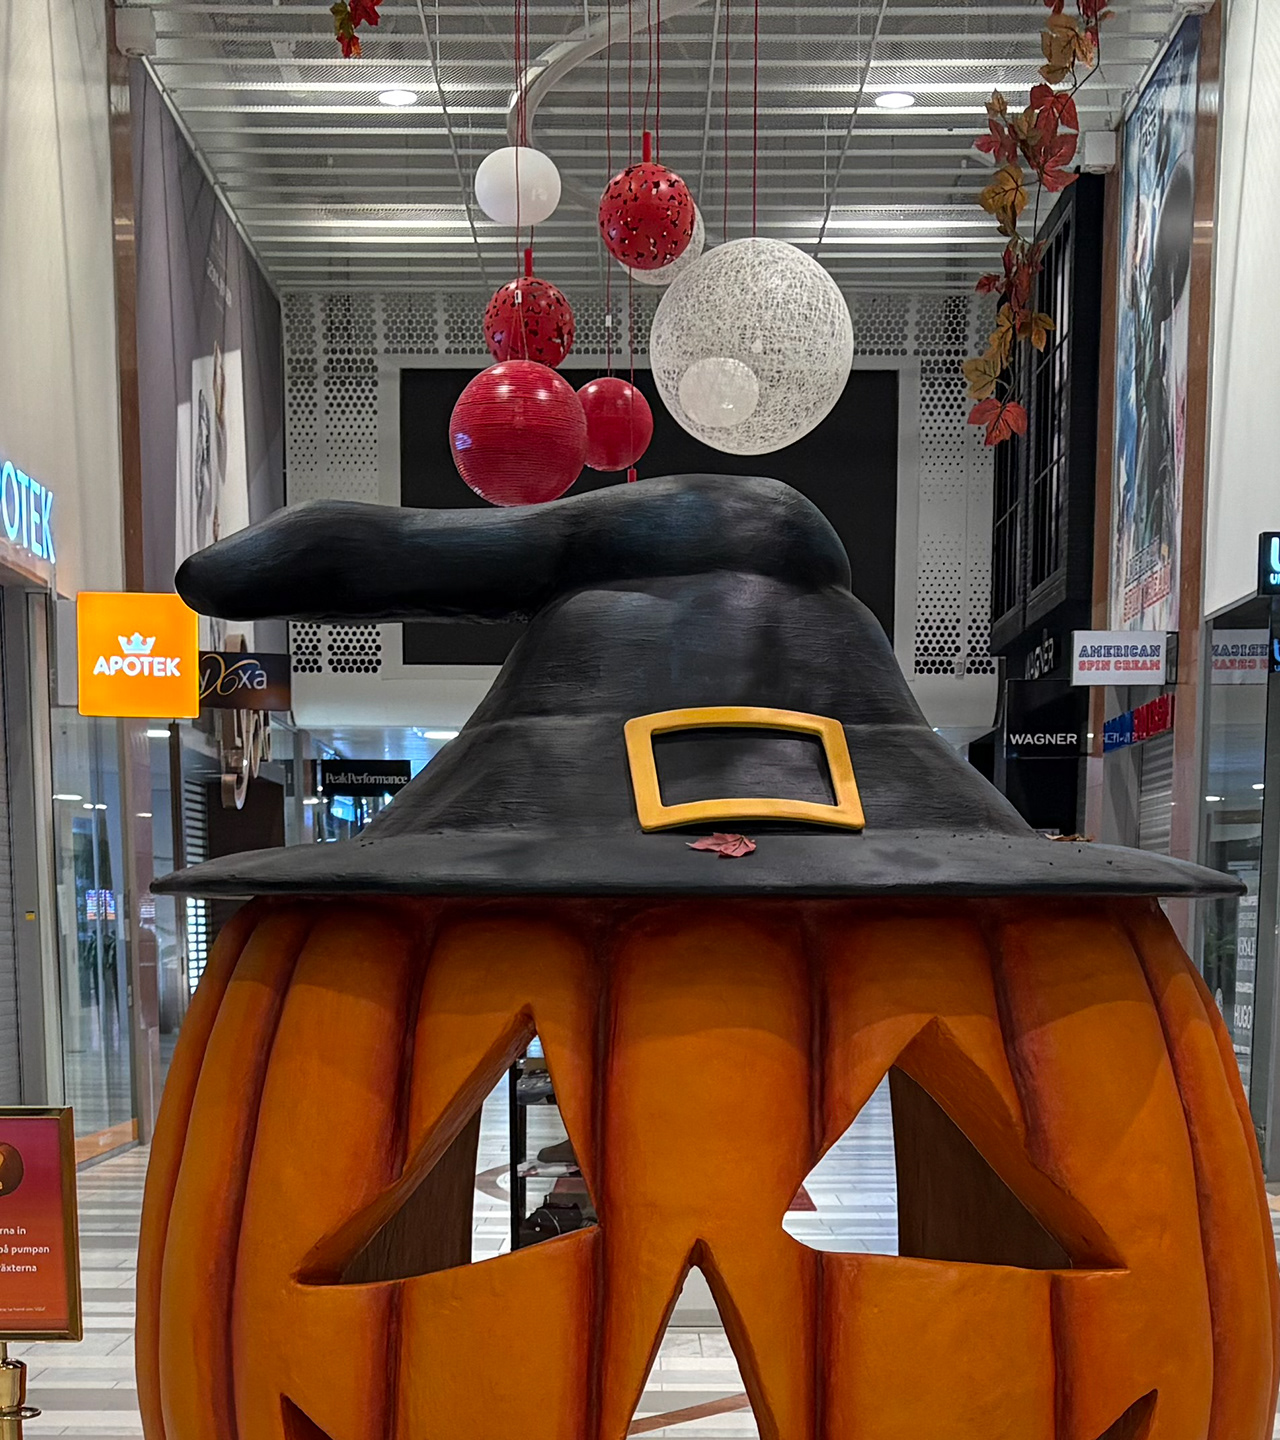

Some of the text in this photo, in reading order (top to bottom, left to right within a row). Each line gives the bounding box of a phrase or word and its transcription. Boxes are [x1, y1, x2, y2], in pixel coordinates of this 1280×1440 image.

[1078, 645, 1161, 657] AMERICAN
[93, 655, 181, 677] APOTEK
[1078, 660, 1161, 671] SPIN CREAM
[1009, 733, 1077, 745] WAGNER
[17, 1226, 26, 1235] in
[11, 1247, 50, 1256] pumpan
